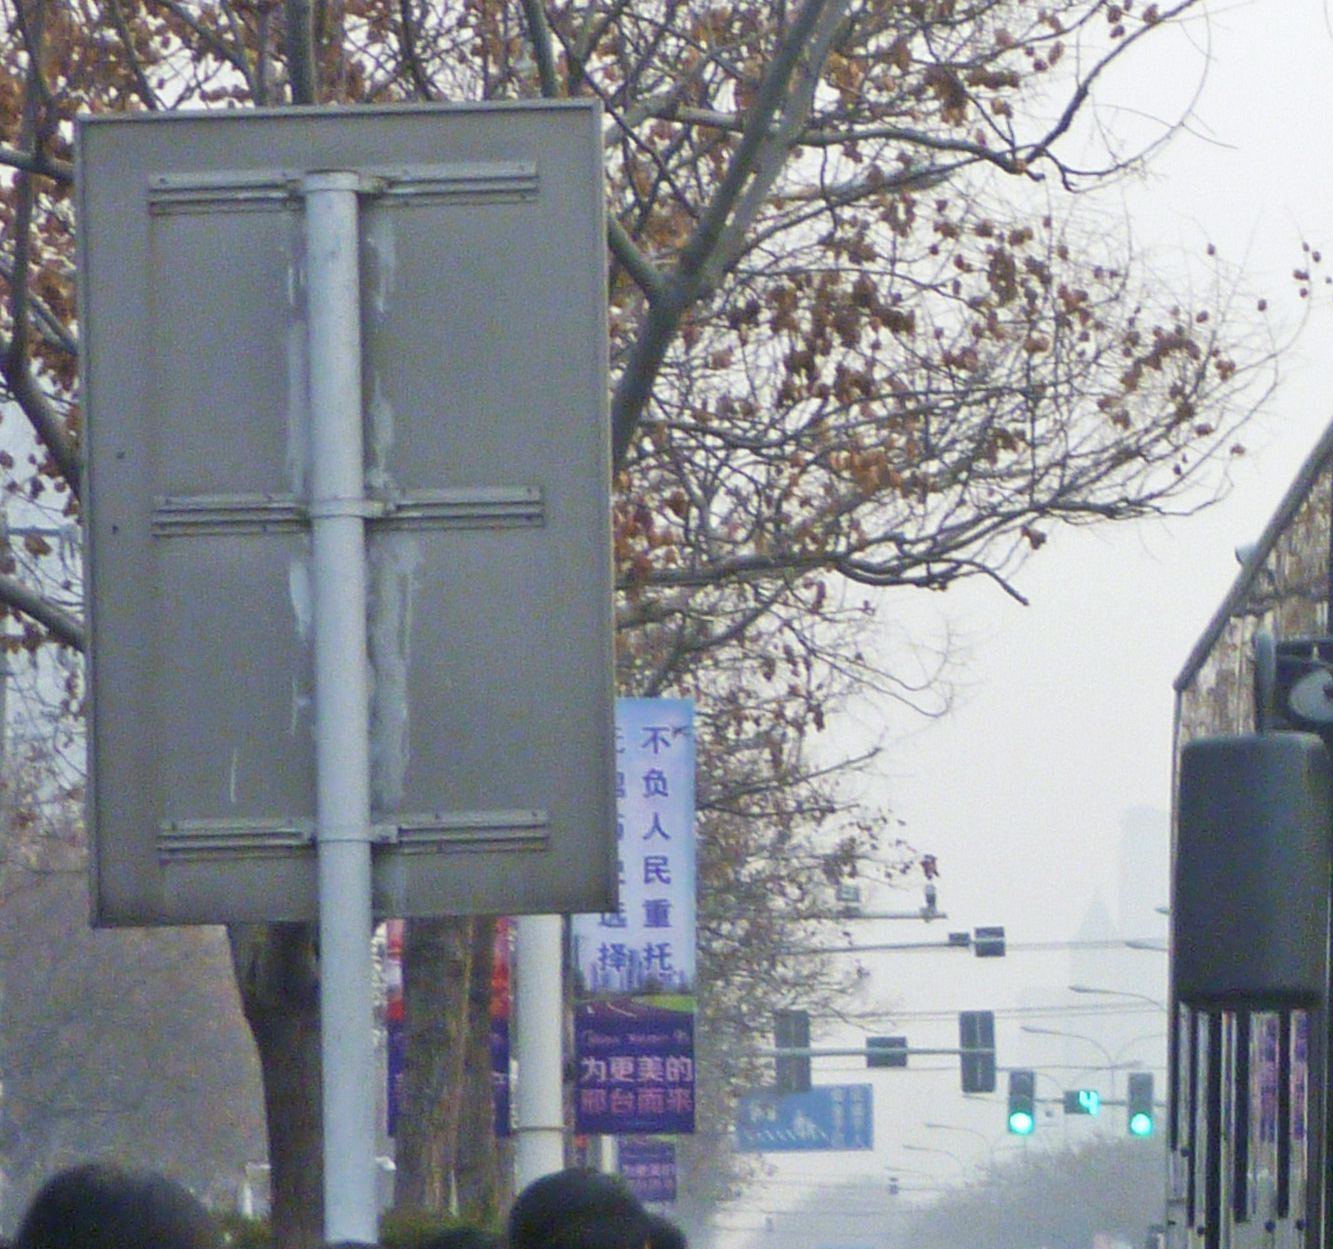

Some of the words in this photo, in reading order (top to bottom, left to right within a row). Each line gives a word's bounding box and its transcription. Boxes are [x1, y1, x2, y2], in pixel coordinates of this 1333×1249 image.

[640, 726, 674, 972] 不负人民重托
[580, 1055, 693, 1083] 为更美的
